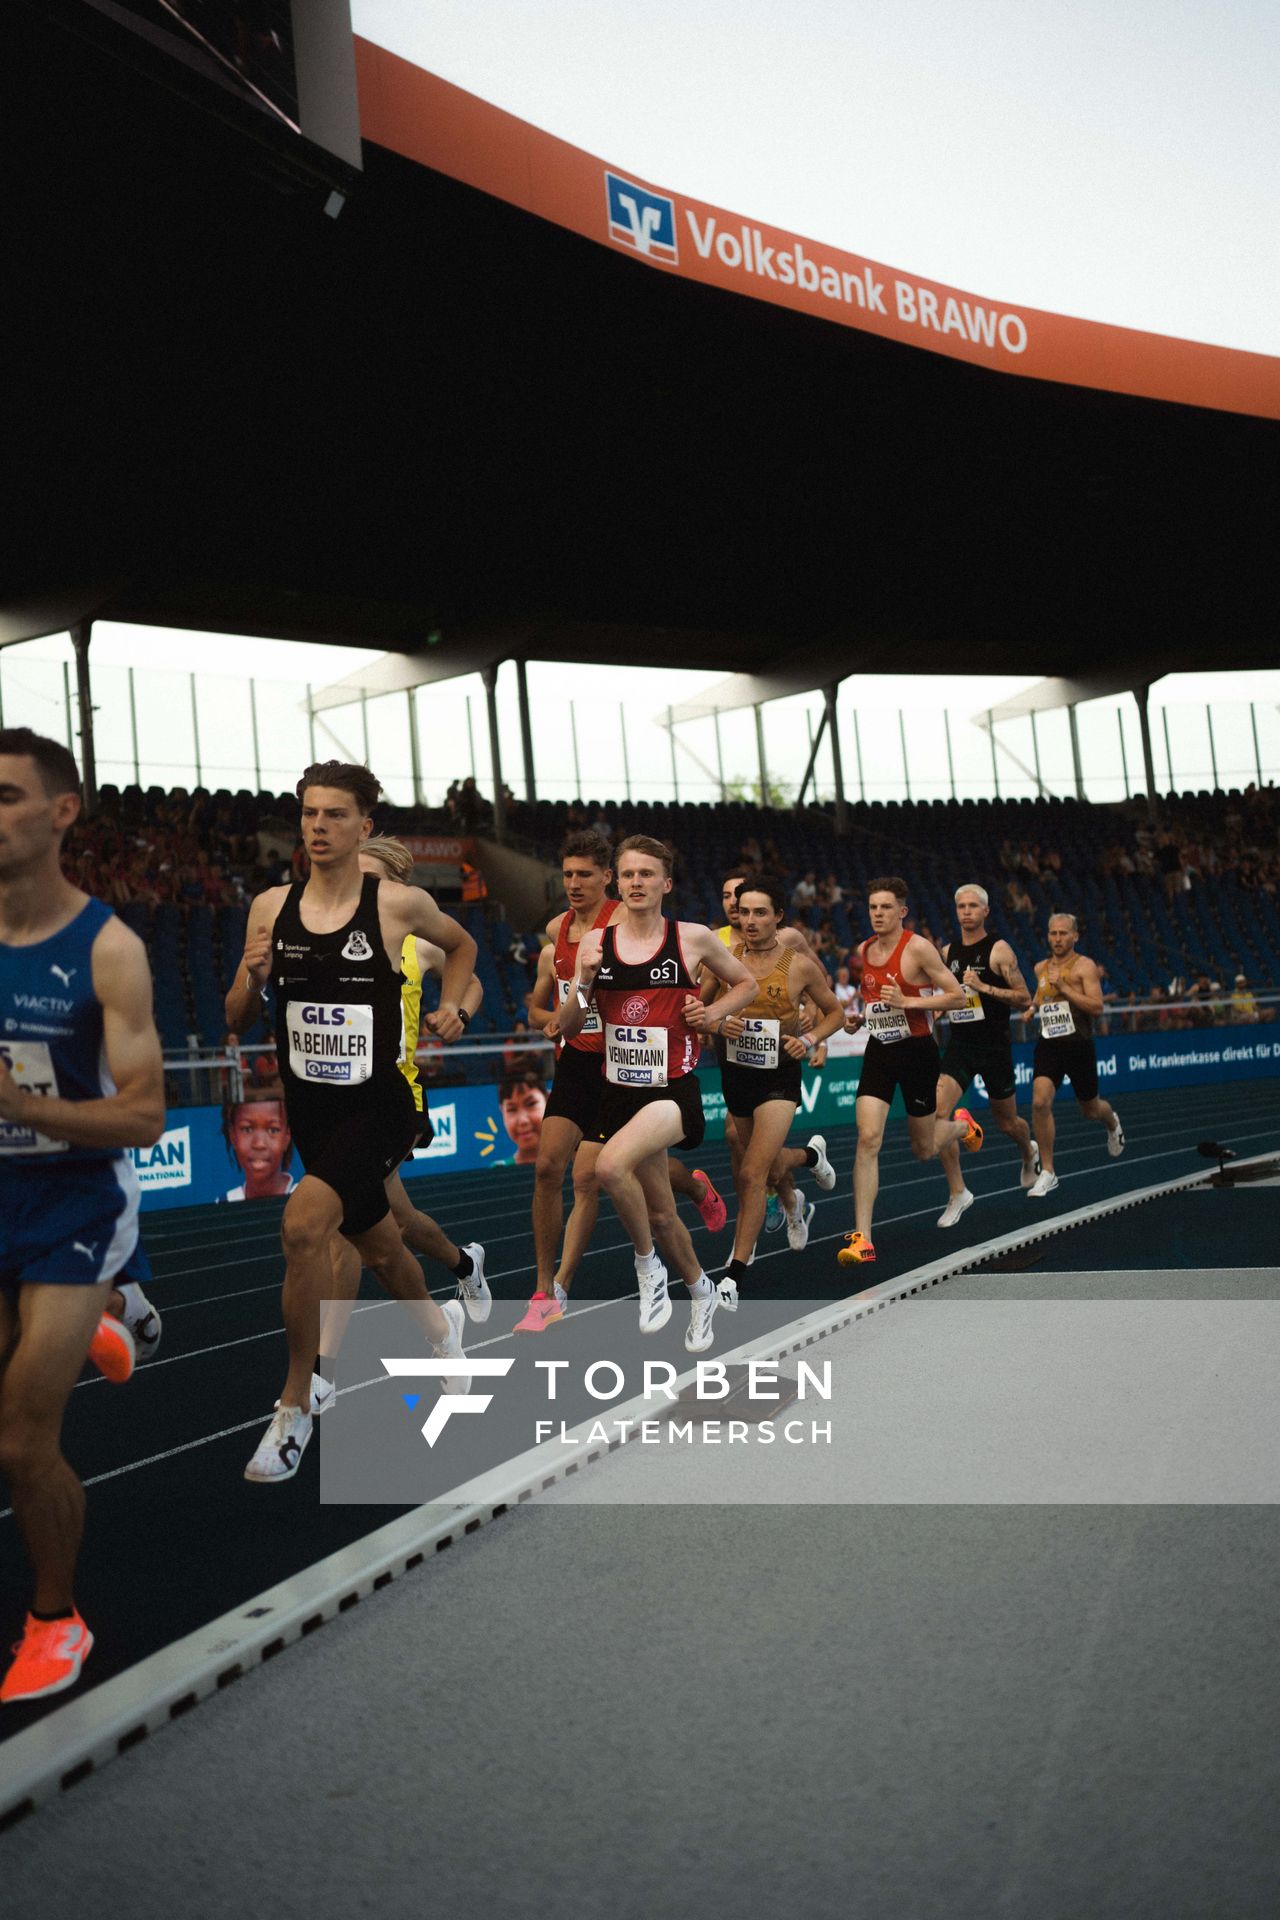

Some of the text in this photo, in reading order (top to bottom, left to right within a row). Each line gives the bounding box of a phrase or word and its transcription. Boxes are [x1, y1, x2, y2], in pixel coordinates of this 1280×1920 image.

[686, 210, 1028, 354] Volksbank BRAWO
[650, 967, 670, 980] OS
[13, 993, 74, 1012] VIACTIV
[292, 1030, 367, 1057] R.BEIMLER
[608, 1046, 664, 1067] VENNEMANN
[747, 1054, 765, 1062] PLAN
[1129, 1055, 1147, 1071] Die
[1149, 1051, 1221, 1069] Krankenkasse
[1222, 1046, 1254, 1062] direkt
[1256, 1044, 1271, 1059] für
[322, 1064, 349, 1074] PLAN
[629, 1071, 651, 1079] PLAN
